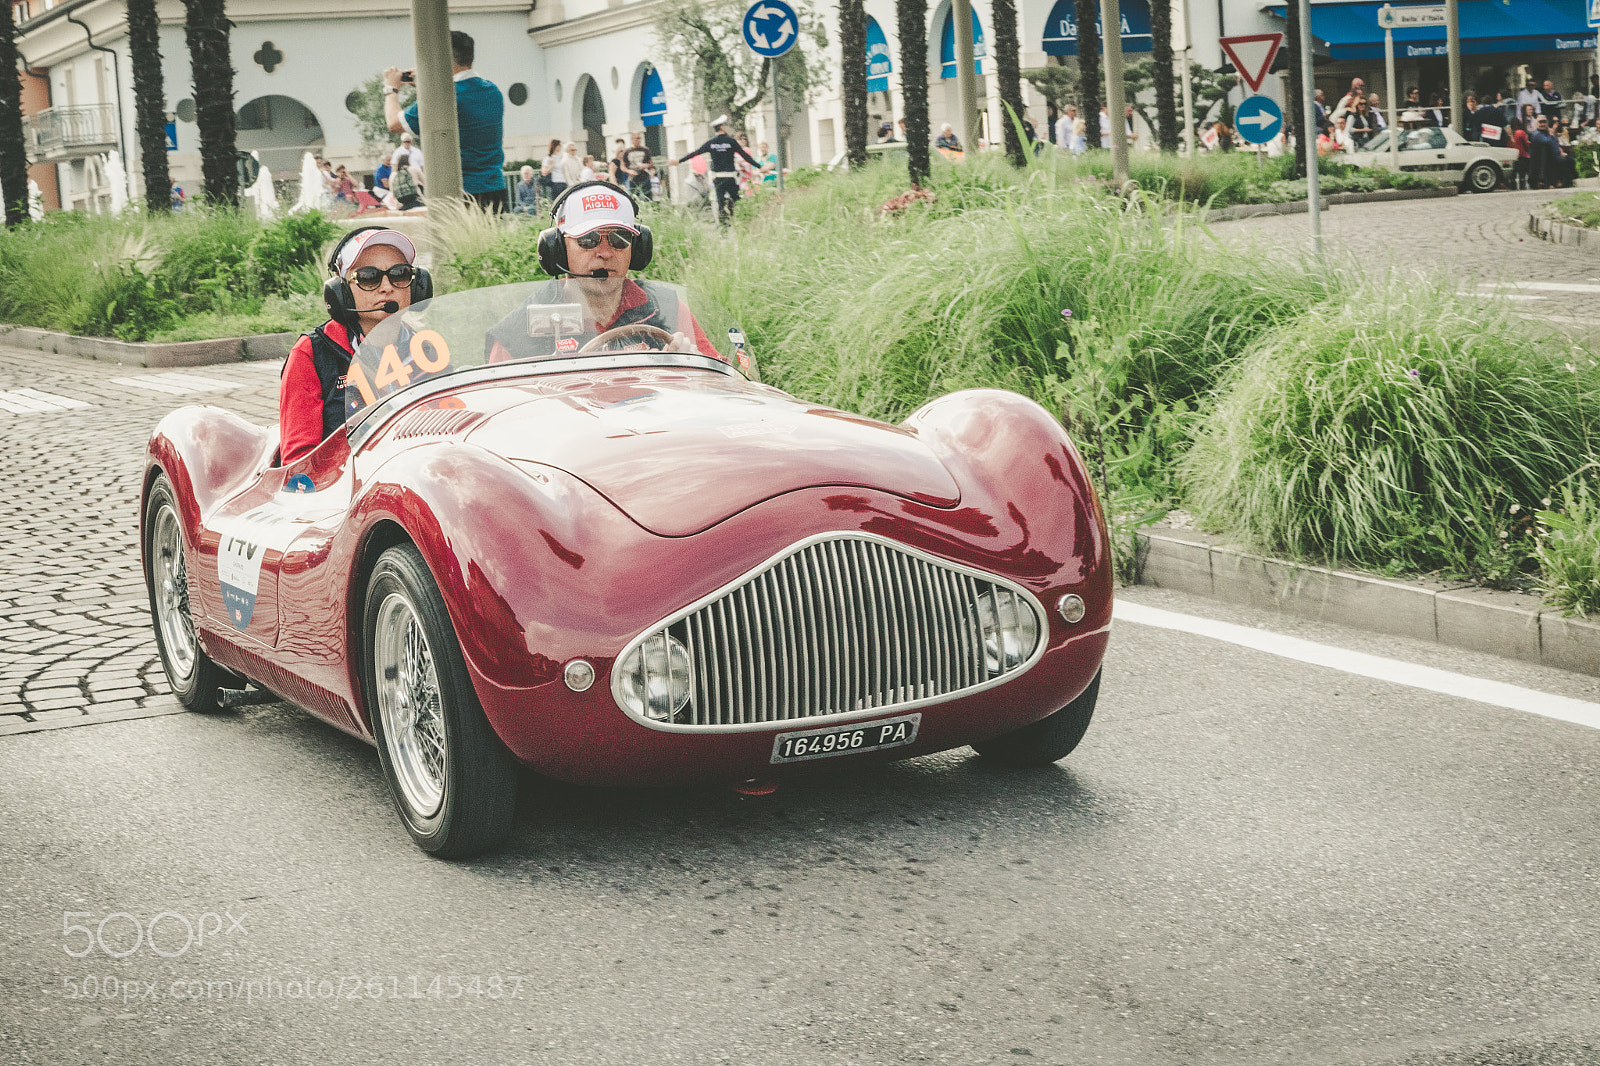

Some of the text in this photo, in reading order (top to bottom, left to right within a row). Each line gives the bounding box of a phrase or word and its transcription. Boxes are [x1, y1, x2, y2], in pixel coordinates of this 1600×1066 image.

[585, 194, 611, 202] 1000
[585, 201, 615, 210] MIGLIA
[347, 329, 451, 407] 140
[784, 722, 907, 757] 164956 PA
